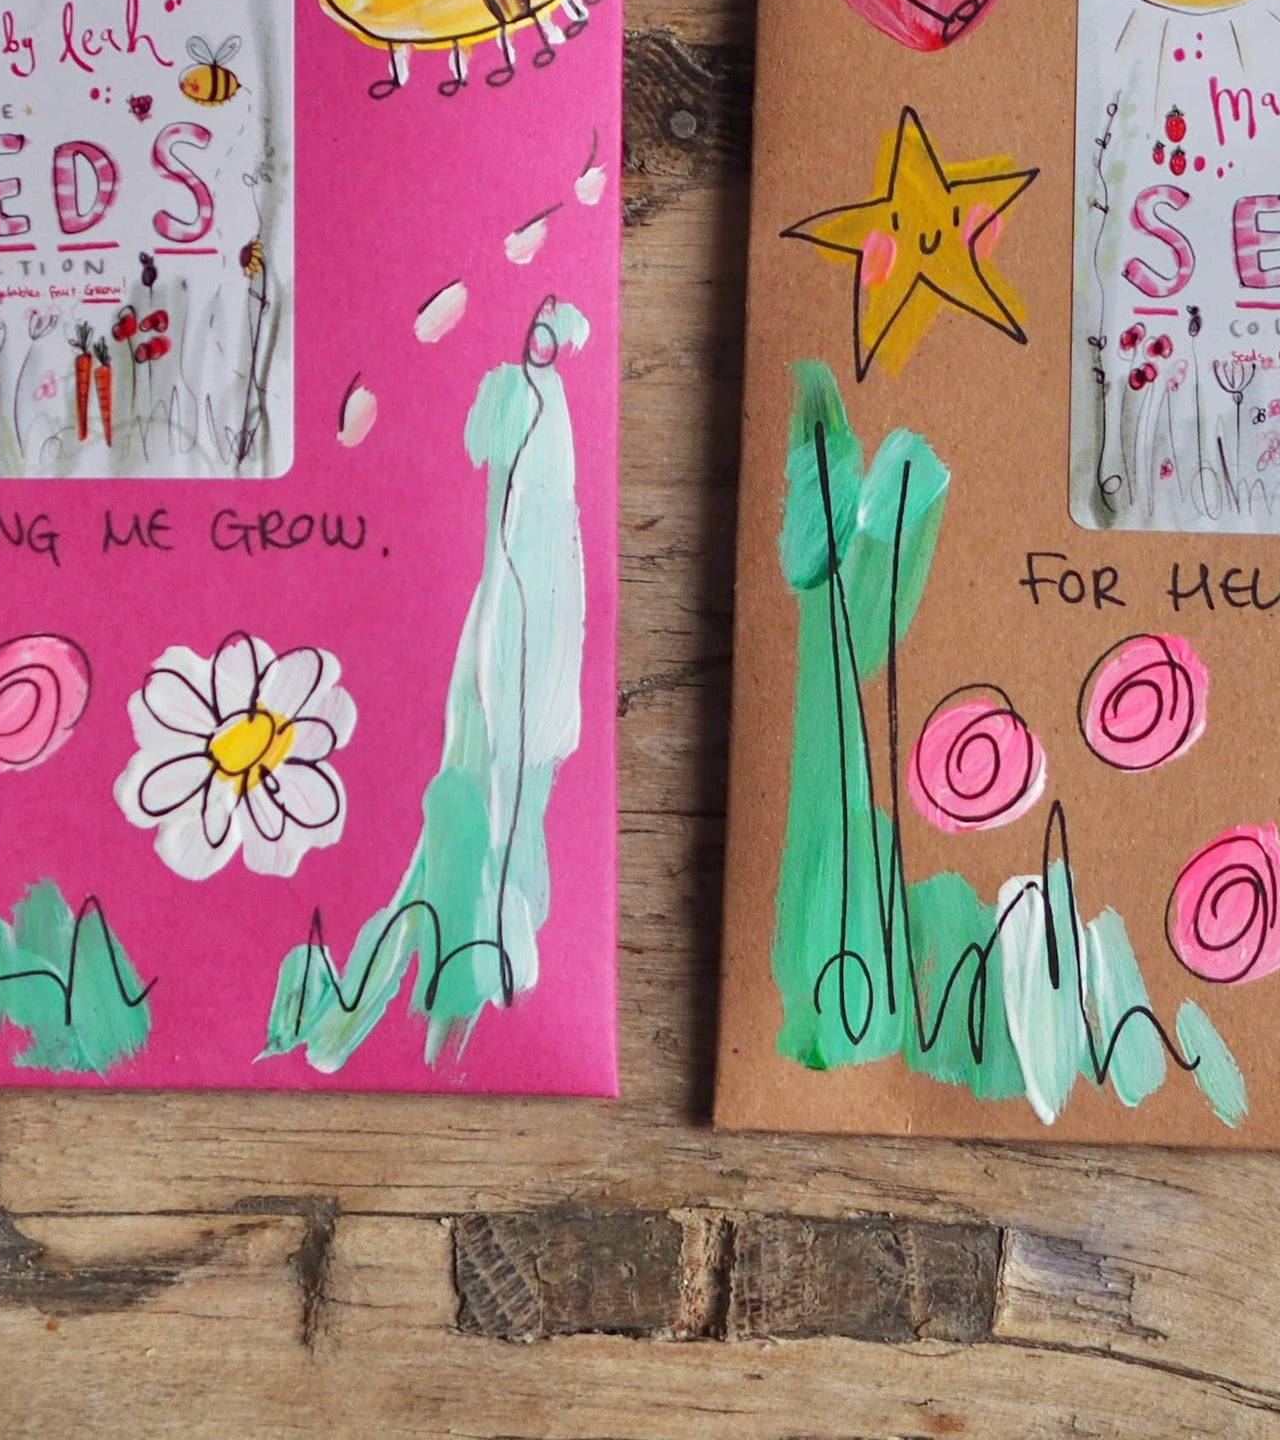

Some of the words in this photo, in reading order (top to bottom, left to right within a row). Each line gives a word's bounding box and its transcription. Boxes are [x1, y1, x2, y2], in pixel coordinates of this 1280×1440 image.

[2, 10, 37, 77] by
[101, 507, 175, 554] ME
[210, 508, 391, 559] GROW.
